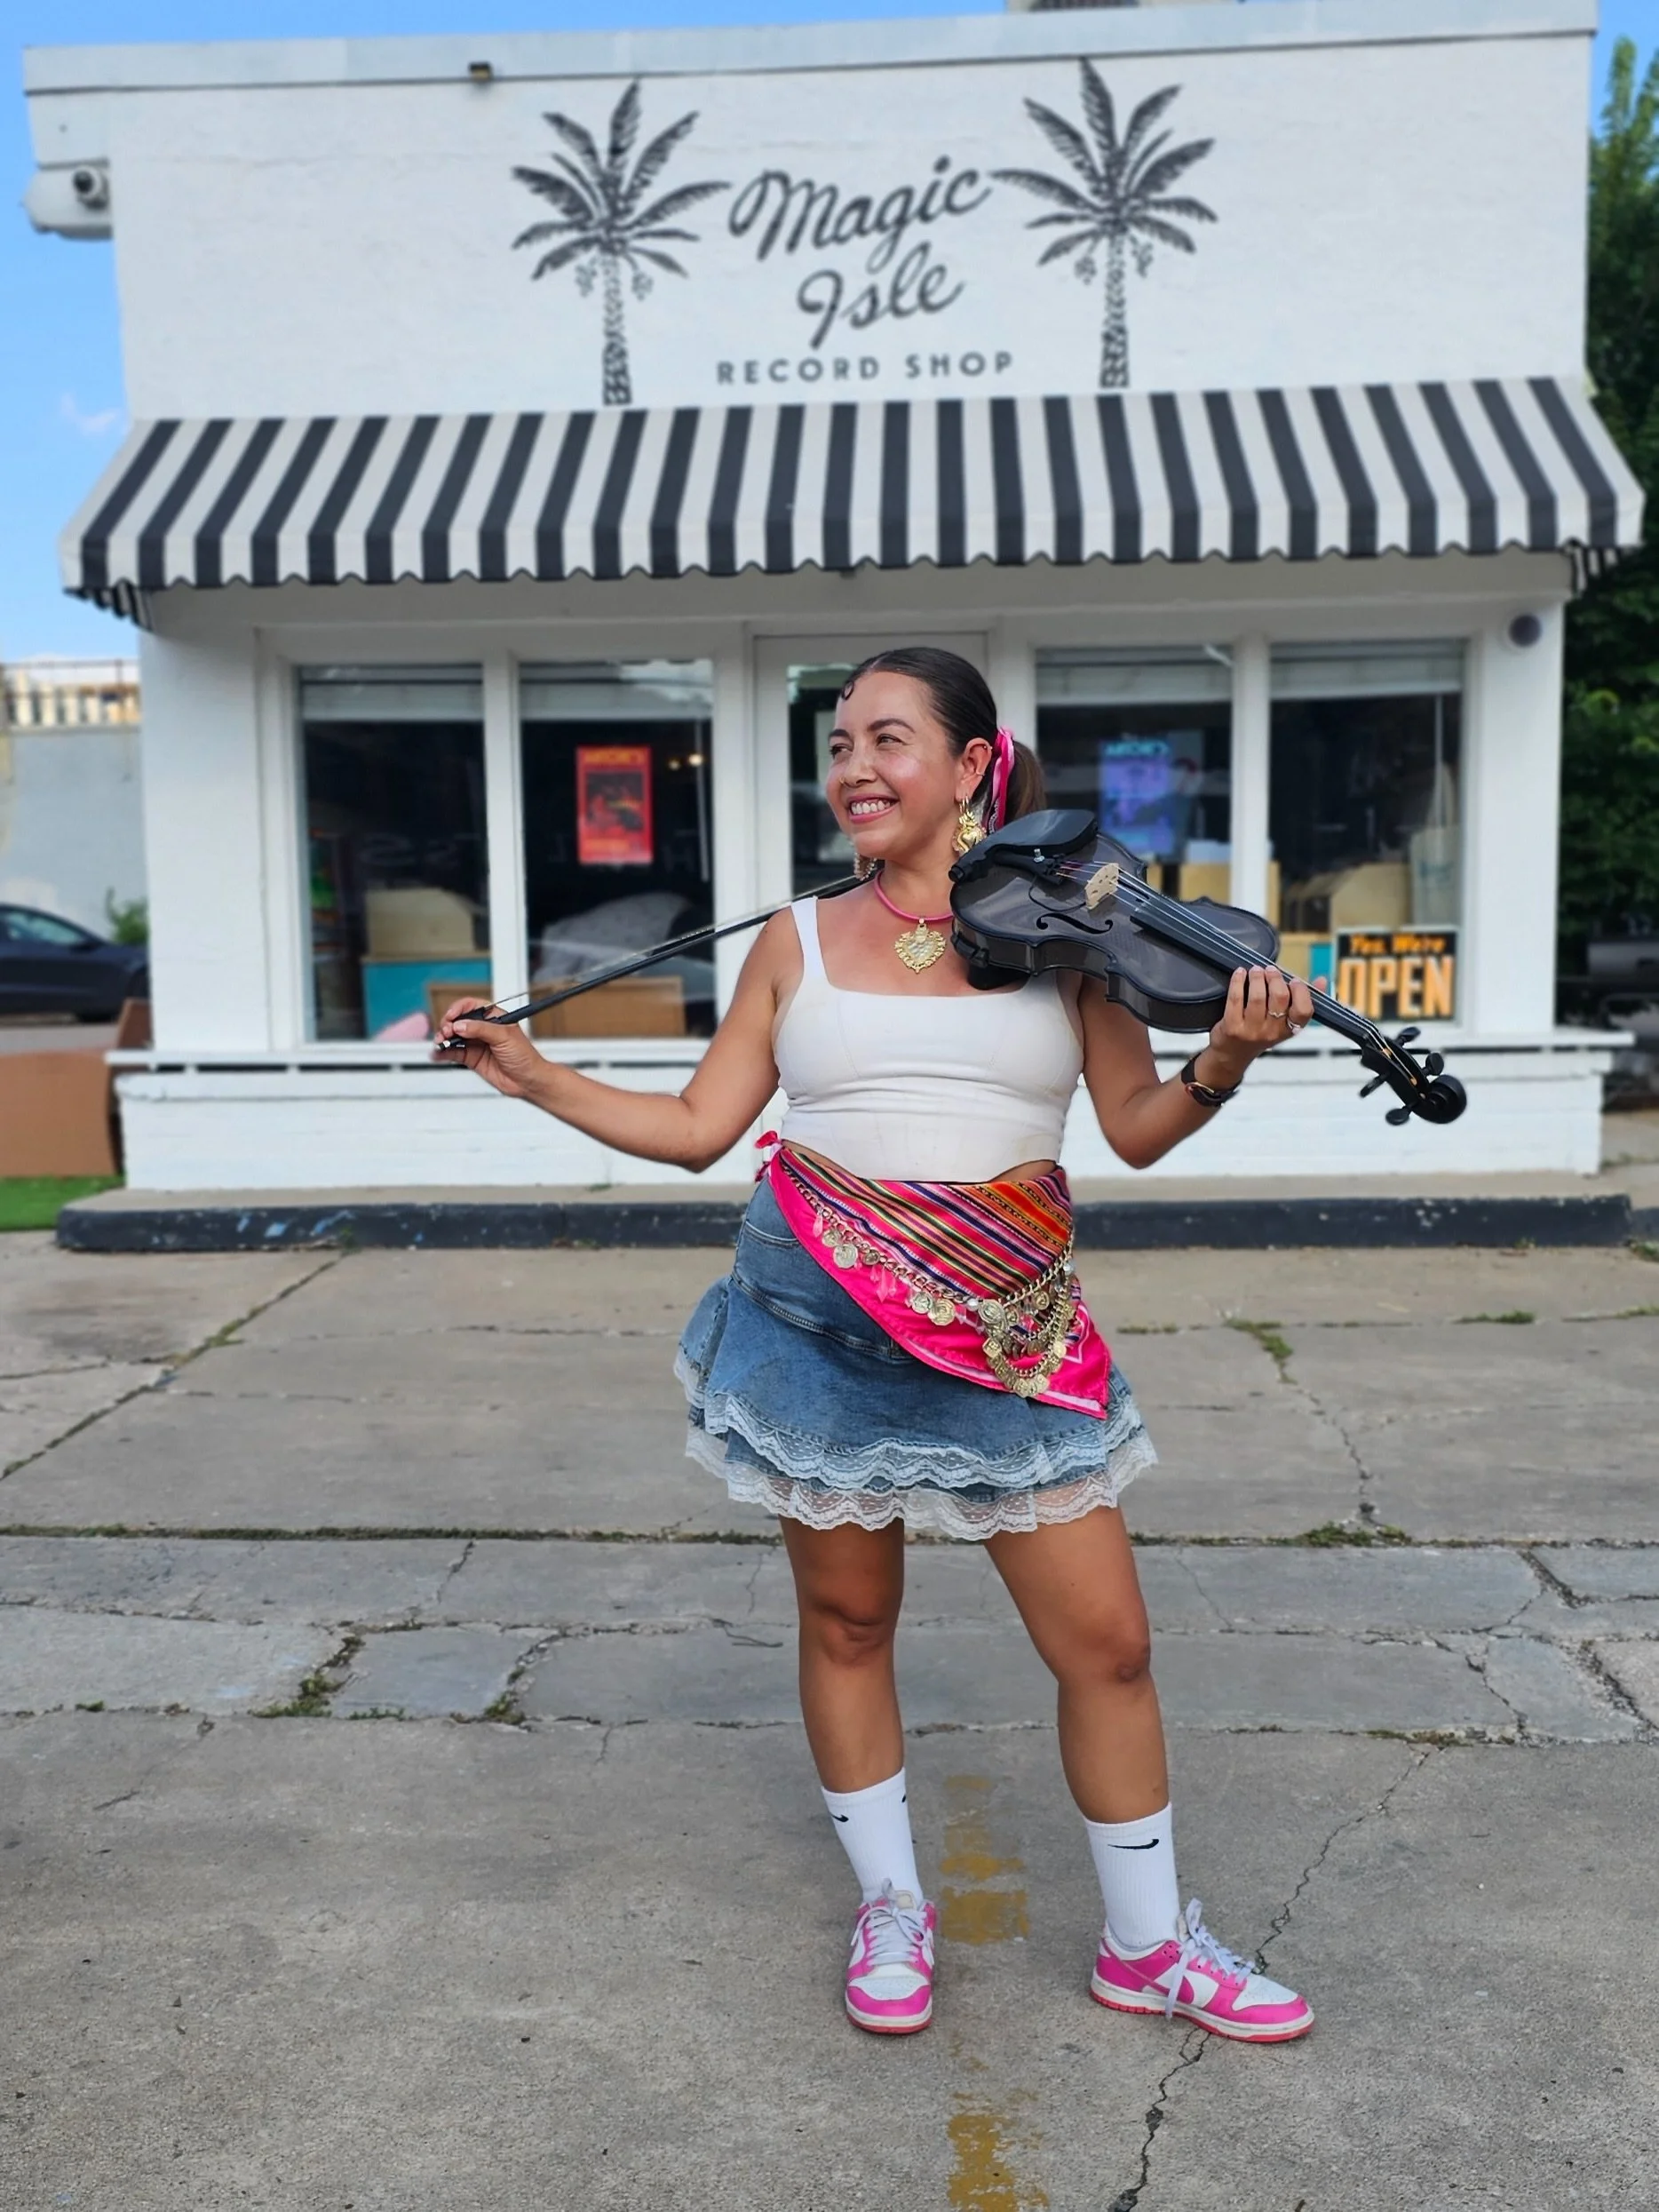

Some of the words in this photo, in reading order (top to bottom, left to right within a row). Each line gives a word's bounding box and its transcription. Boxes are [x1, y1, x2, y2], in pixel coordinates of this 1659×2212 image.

[728, 155, 993, 275] Magic
[796, 240, 967, 350] Isle
[716, 355, 880, 385] RECORD
[905, 350, 1013, 378] SHOP
[1337, 955, 1454, 1018] OPEN
